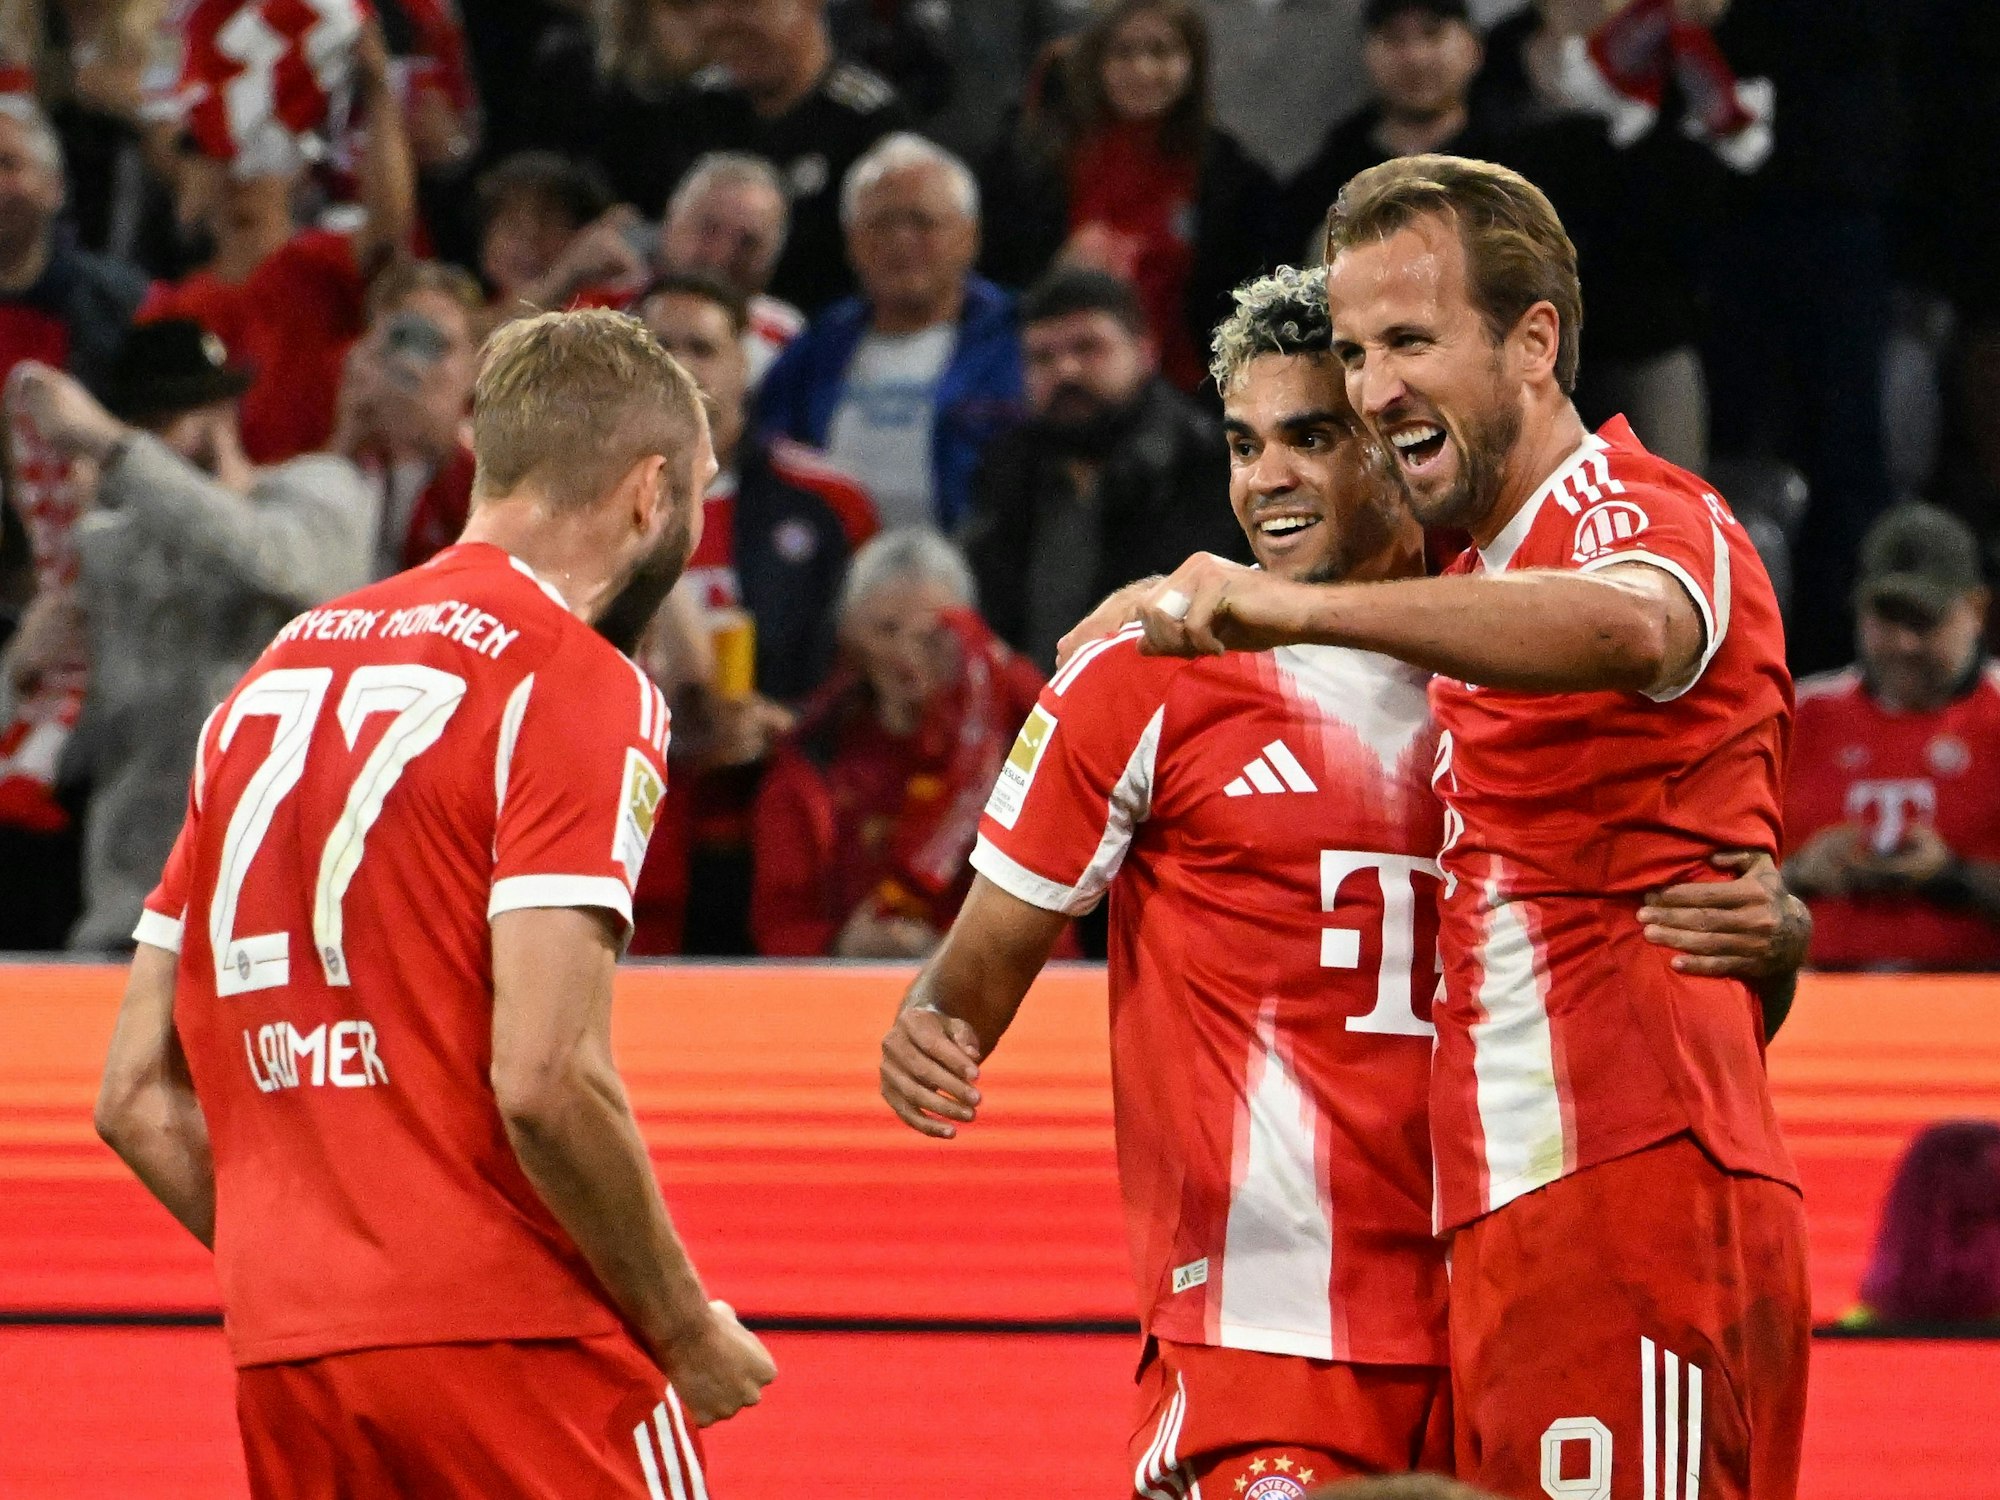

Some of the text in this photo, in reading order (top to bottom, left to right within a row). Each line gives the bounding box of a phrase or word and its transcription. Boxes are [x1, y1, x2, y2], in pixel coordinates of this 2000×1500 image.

[209, 663, 467, 999] 27
[1319, 848, 1447, 1037] T
[1250, 1480, 1300, 1498] BAYERN
